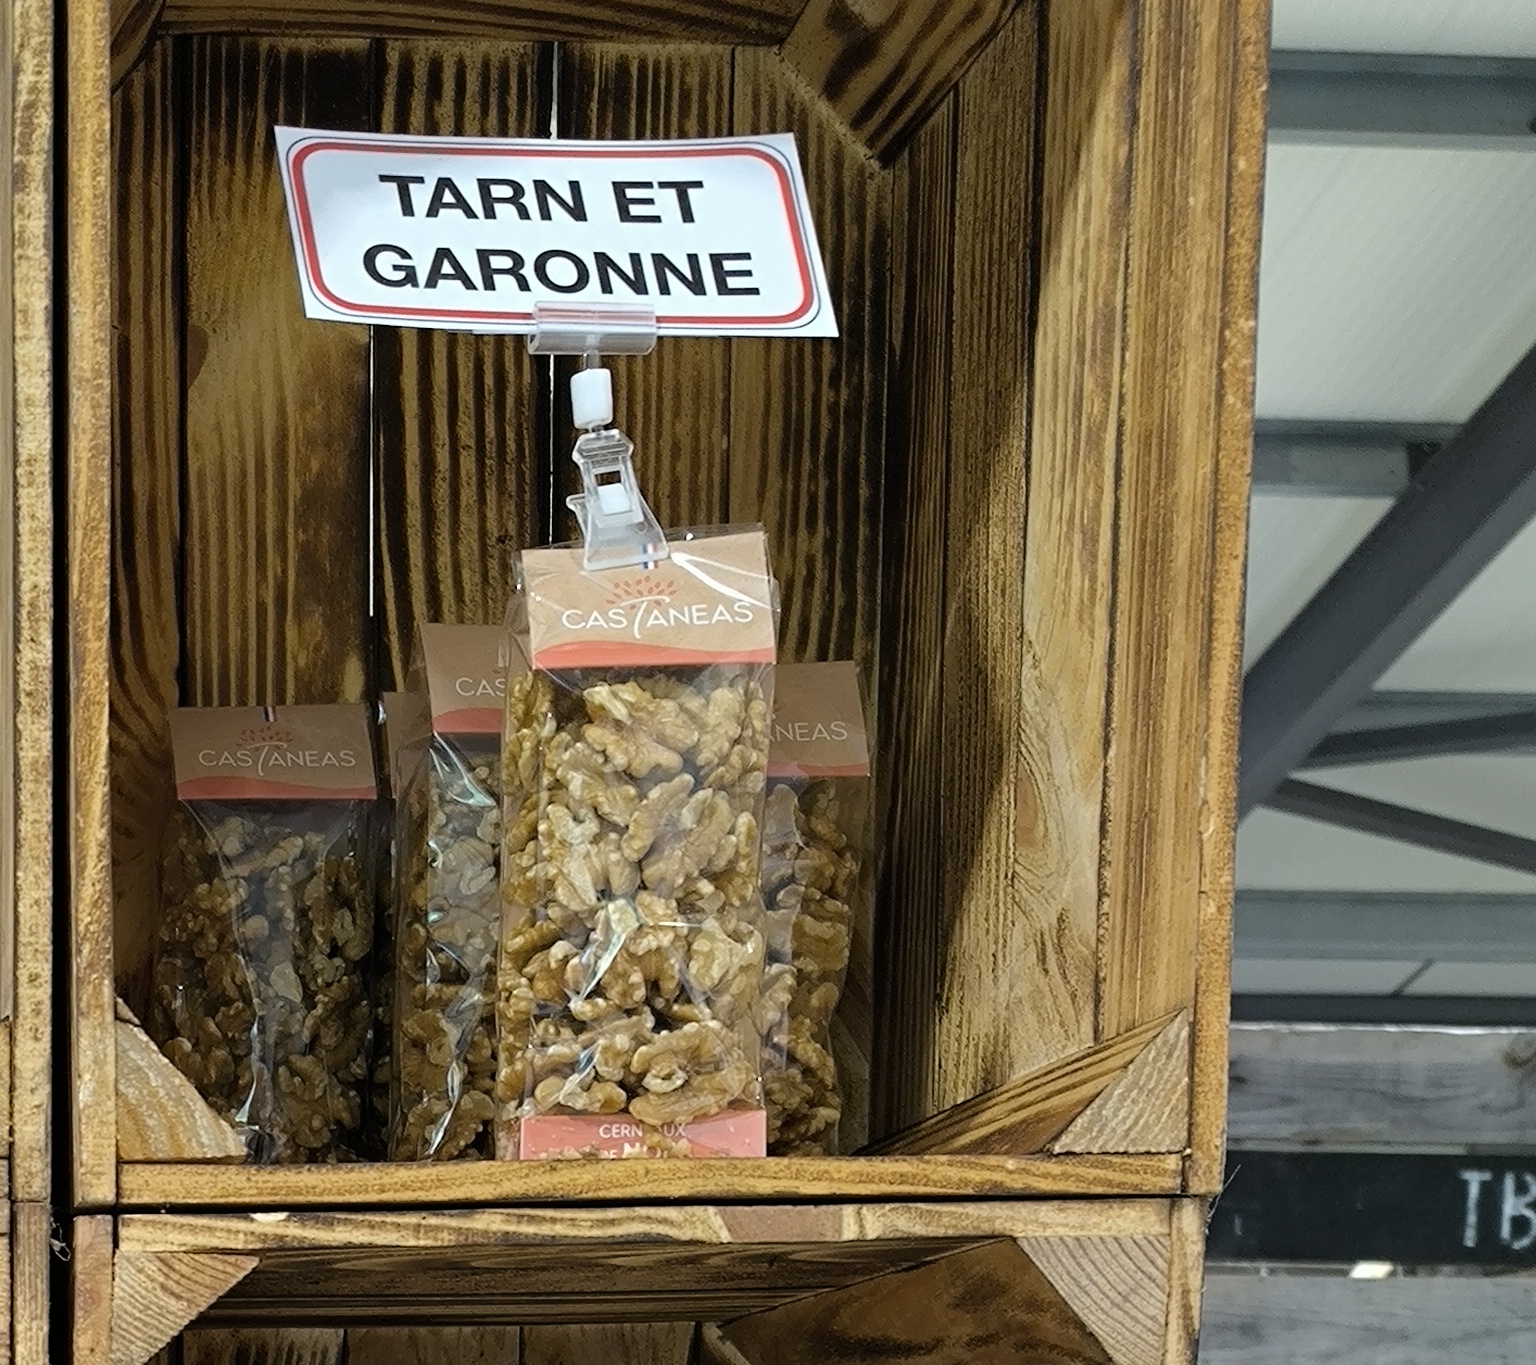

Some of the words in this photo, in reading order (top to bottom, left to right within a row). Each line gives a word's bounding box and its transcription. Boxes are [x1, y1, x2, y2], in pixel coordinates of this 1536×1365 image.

[378, 173, 589, 223] TARN
[611, 180, 704, 224] ET
[362, 243, 761, 297] GARONNE
[562, 595, 755, 638] CASTANEAS
[199, 742, 356, 776] CASTANEAS
[599, 1124, 686, 1138] CERNUX
